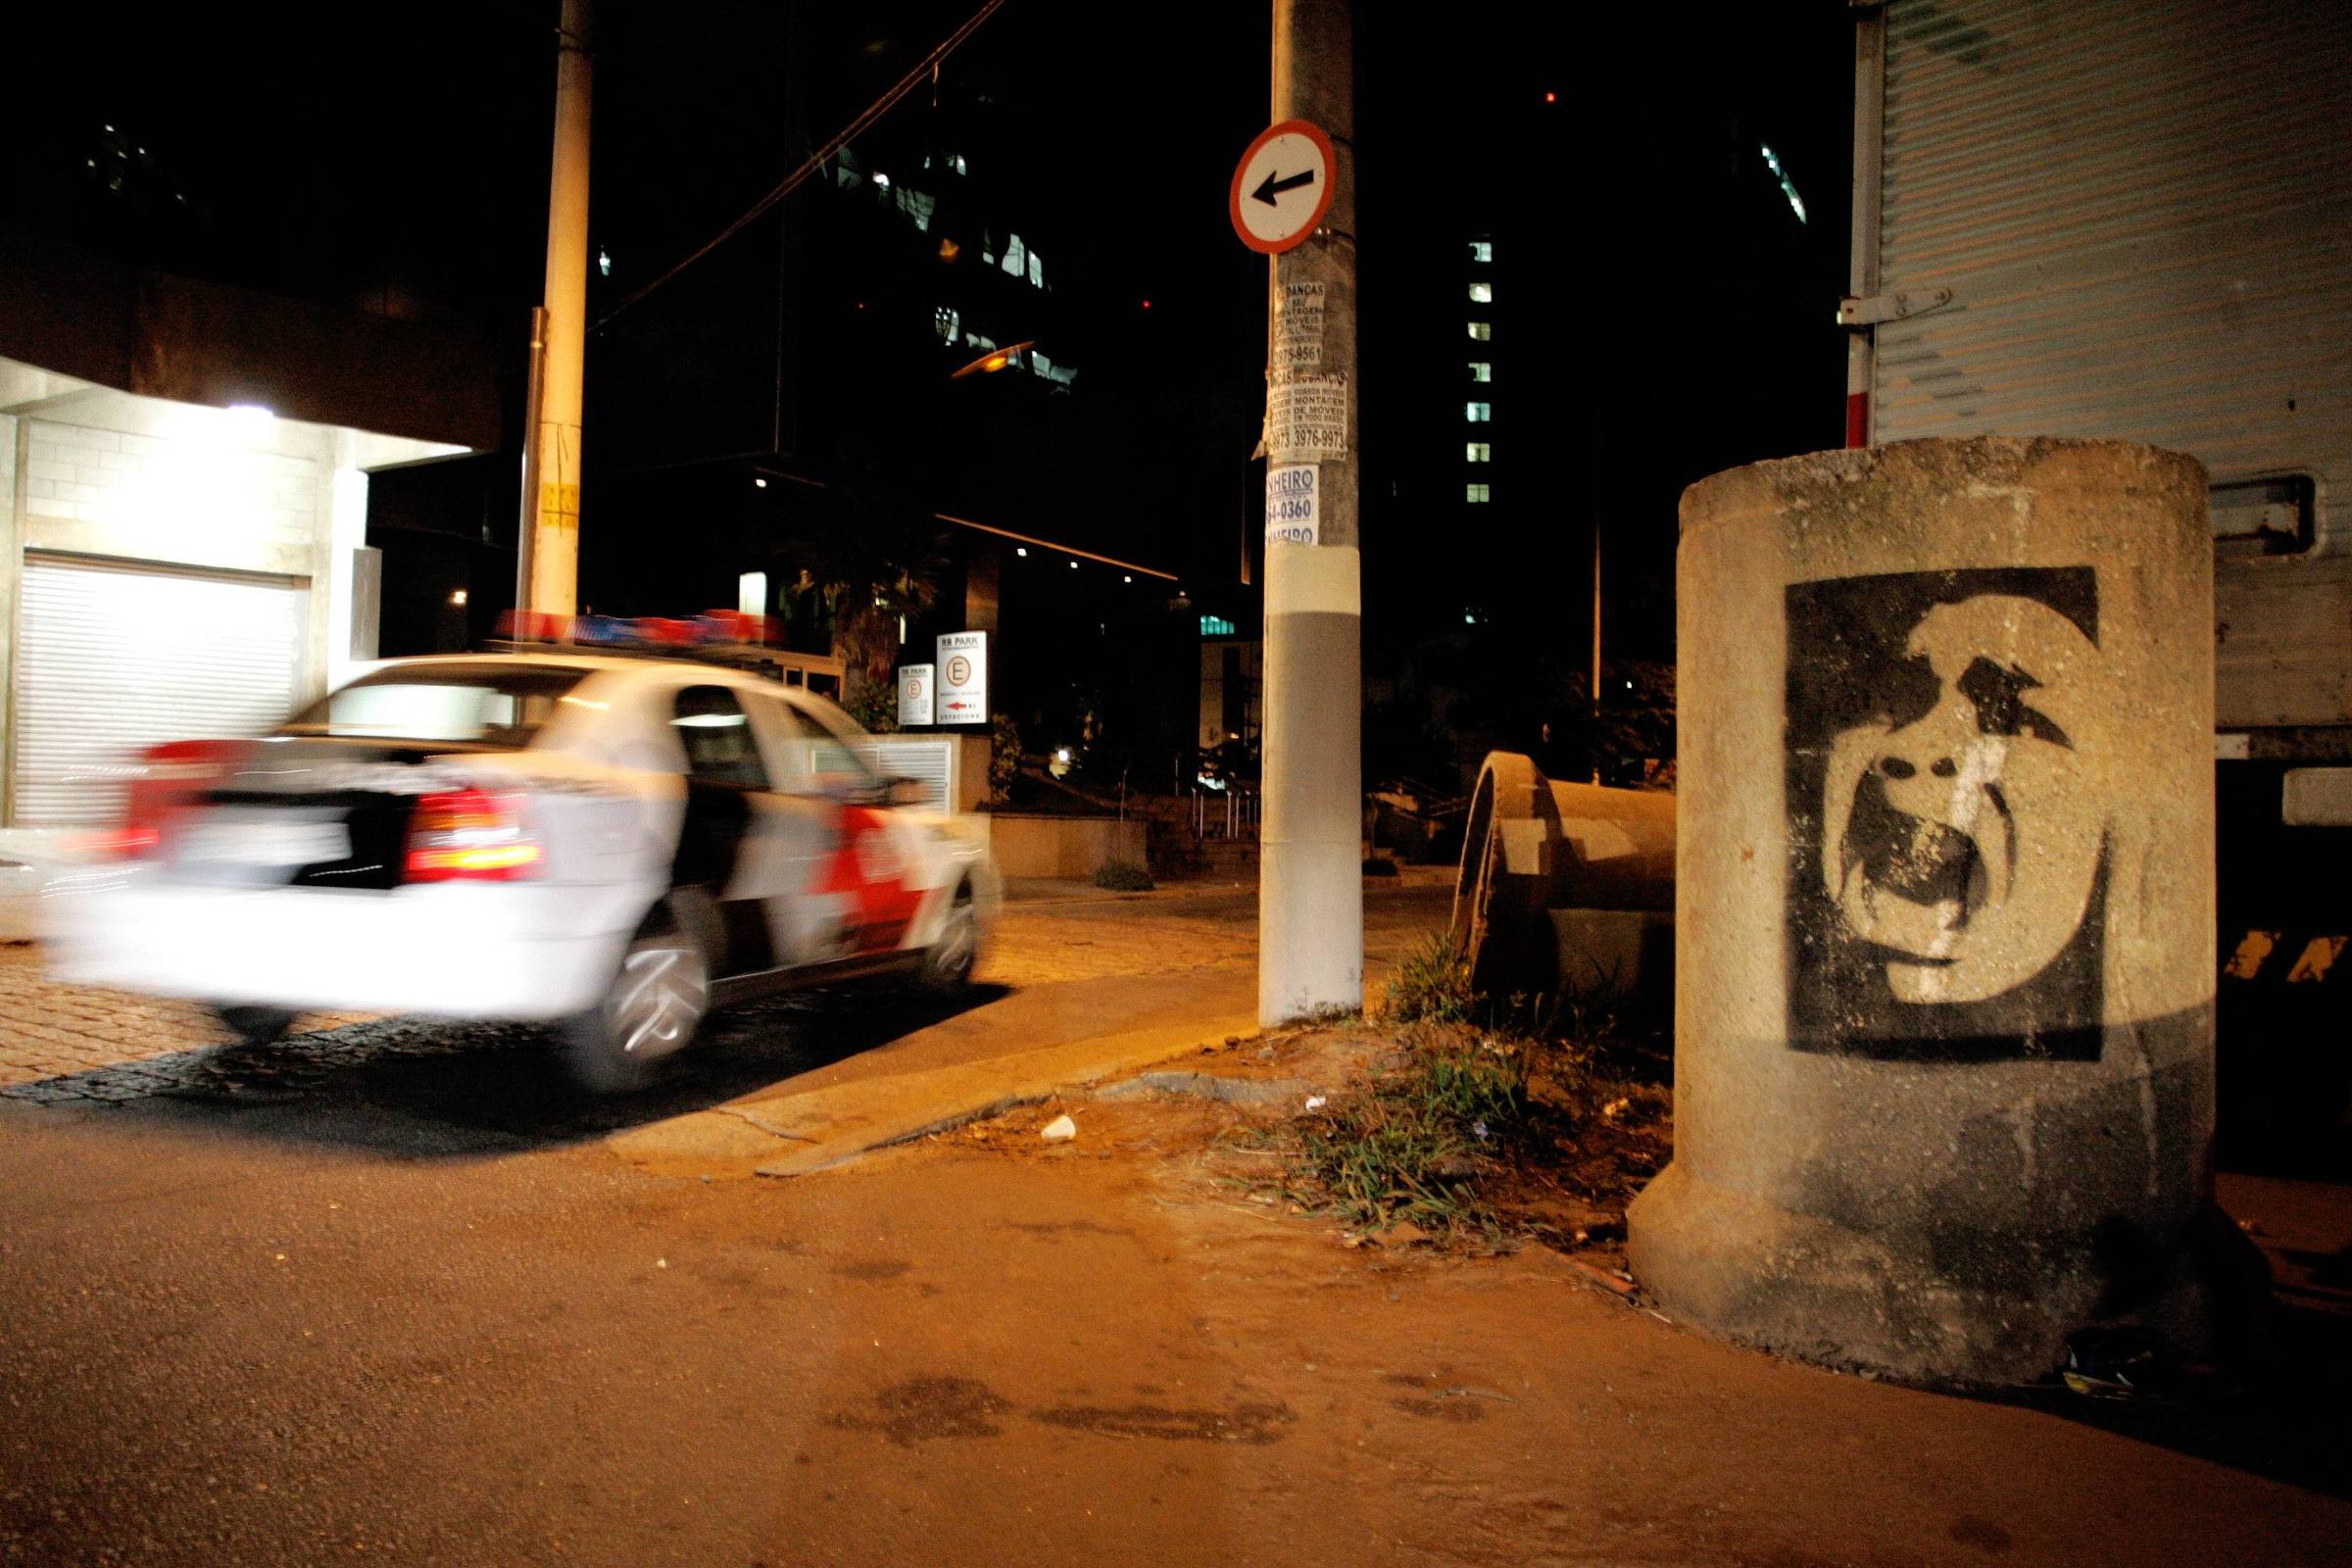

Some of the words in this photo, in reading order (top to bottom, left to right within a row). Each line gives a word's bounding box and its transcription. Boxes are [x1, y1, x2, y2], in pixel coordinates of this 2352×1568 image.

[1295, 396, 1345, 406] MONTAEM
[1294, 429, 1345, 448] 3976-9973
[955, 636, 978, 646] PARK
